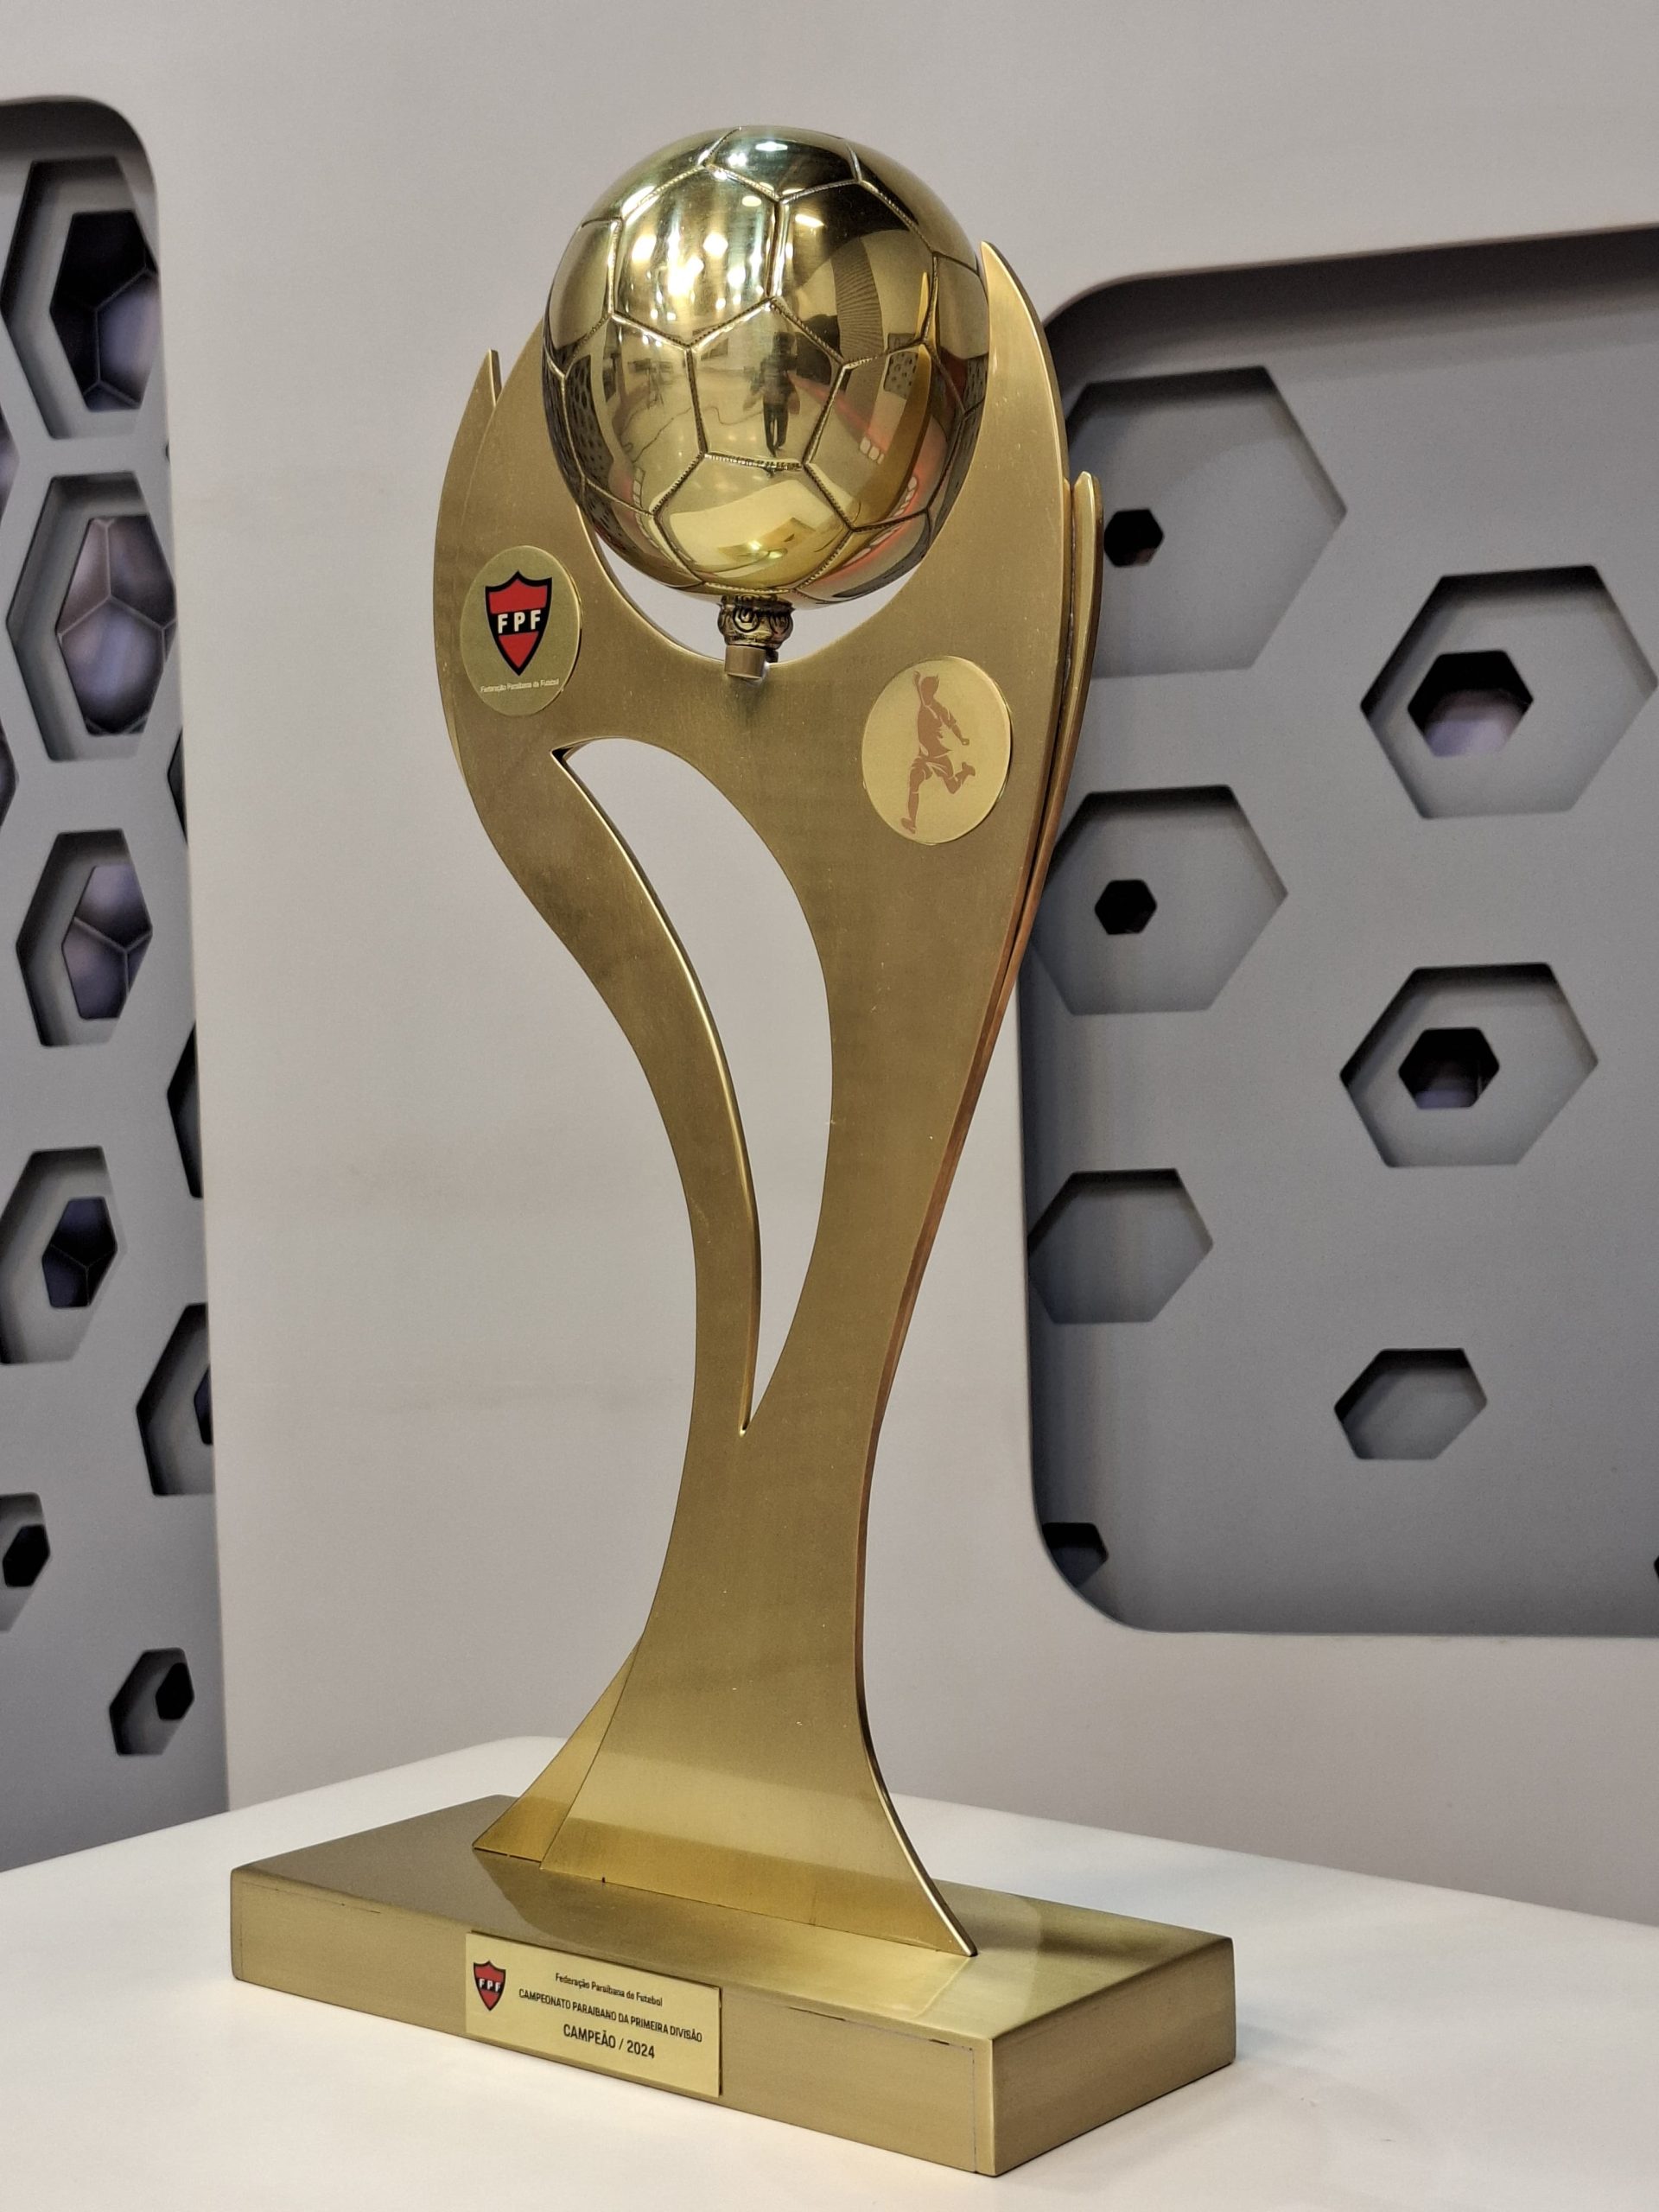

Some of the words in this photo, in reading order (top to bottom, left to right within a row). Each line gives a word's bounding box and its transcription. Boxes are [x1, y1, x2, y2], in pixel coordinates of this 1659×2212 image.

[497, 609, 542, 634] FPF
[479, 1978, 502, 1993] FPF
[518, 1987, 571, 2010] CAMPEONATO
[618, 2012, 630, 2024] DA
[630, 2015, 669, 2035] PRIMEIRA
[563, 2024, 616, 2049] CAMPEÃO
[618, 2037, 624, 2050] /
[626, 2039, 655, 2059] 2024
